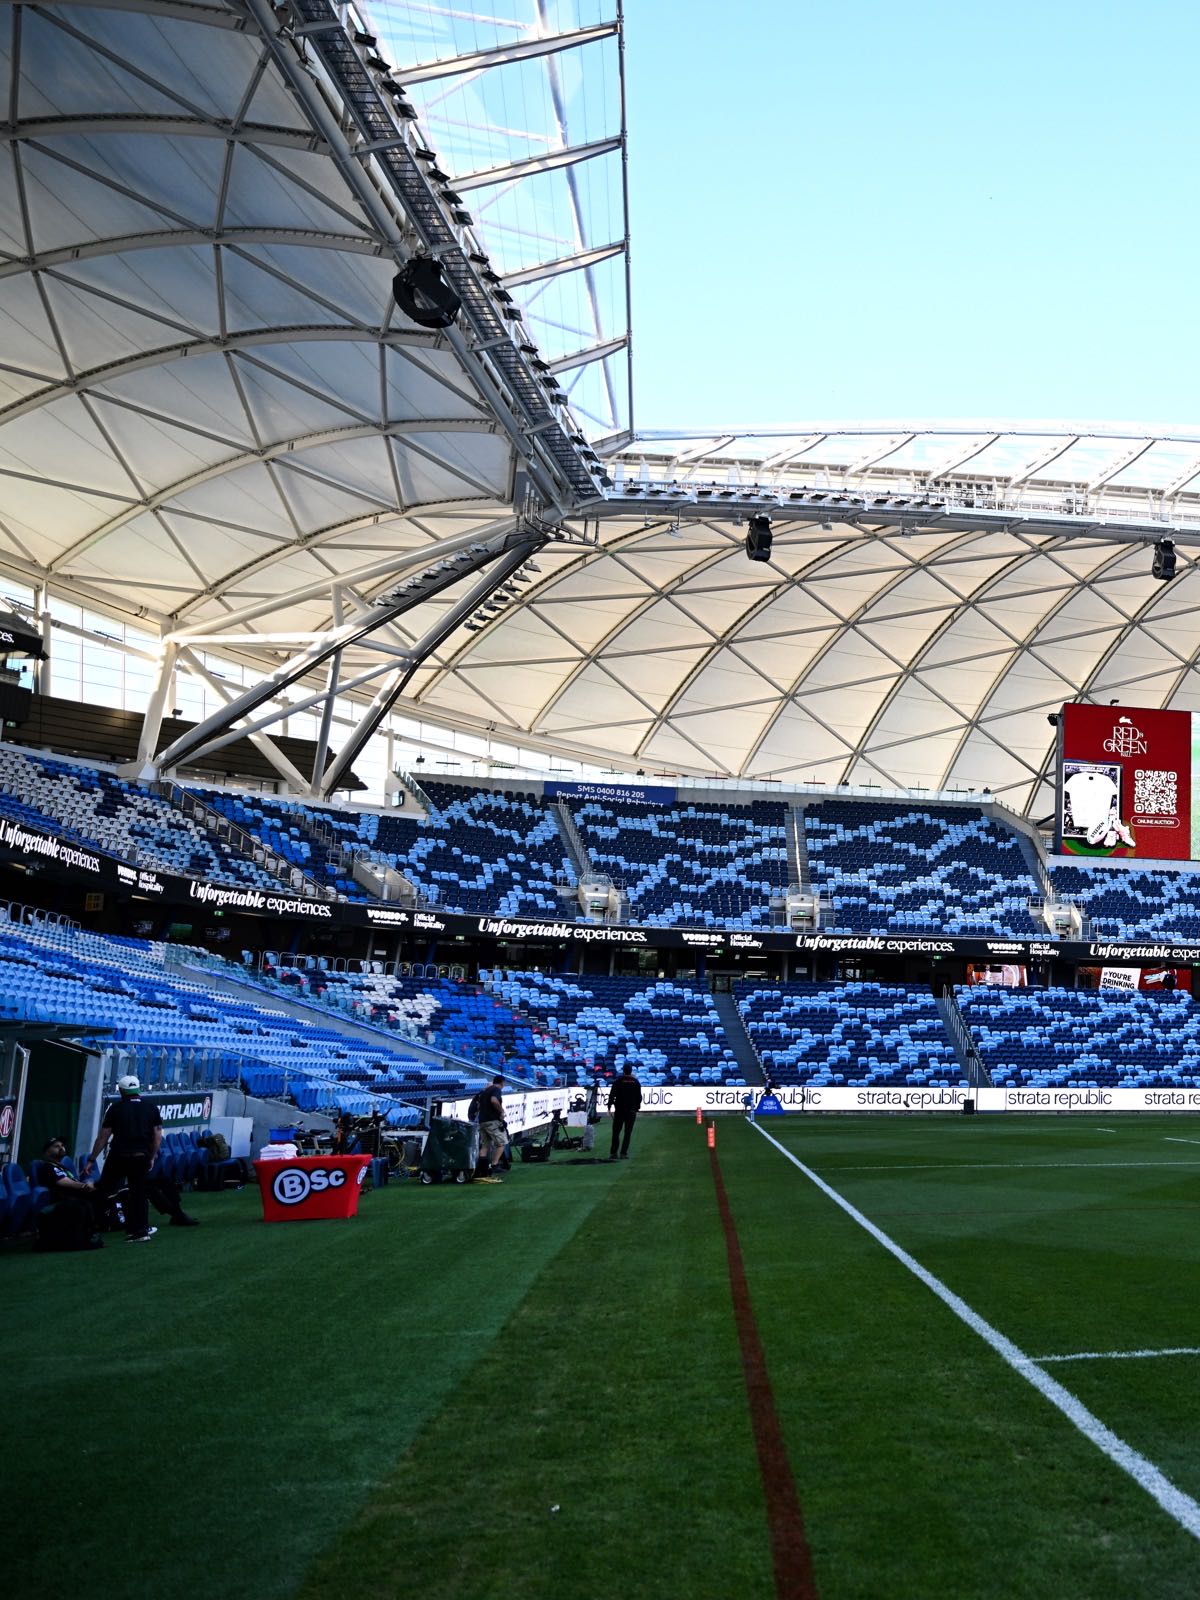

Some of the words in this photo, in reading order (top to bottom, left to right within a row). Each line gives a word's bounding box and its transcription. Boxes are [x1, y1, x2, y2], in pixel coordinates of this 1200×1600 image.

[1113, 726, 1140, 741] RED
[1103, 739, 1147, 754] GREEN
[577, 785, 595, 793] SMS
[596, 787, 615, 795] 0400
[616, 789, 630, 797] 816
[190, 880, 266, 908] Unforgettable
[267, 899, 332, 917] experiences.
[478, 918, 573, 937] Unforgettable
[574, 927, 647, 942] experiences.
[796, 935, 885, 951] Unforgettable
[886, 938, 955, 953] experiences.
[987, 942, 1025, 951] venues.
[1090, 943, 1171, 959] Unforgettable
[1102, 977, 1135, 989] DRINKING
[1108, 971, 1132, 982] YOU'RE
[857, 1091, 902, 1104] strata
[905, 1089, 966, 1109] republic
[1008, 1091, 1050, 1105] strata
[1054, 1089, 1112, 1108] republic
[1144, 1092, 1185, 1105] strata
